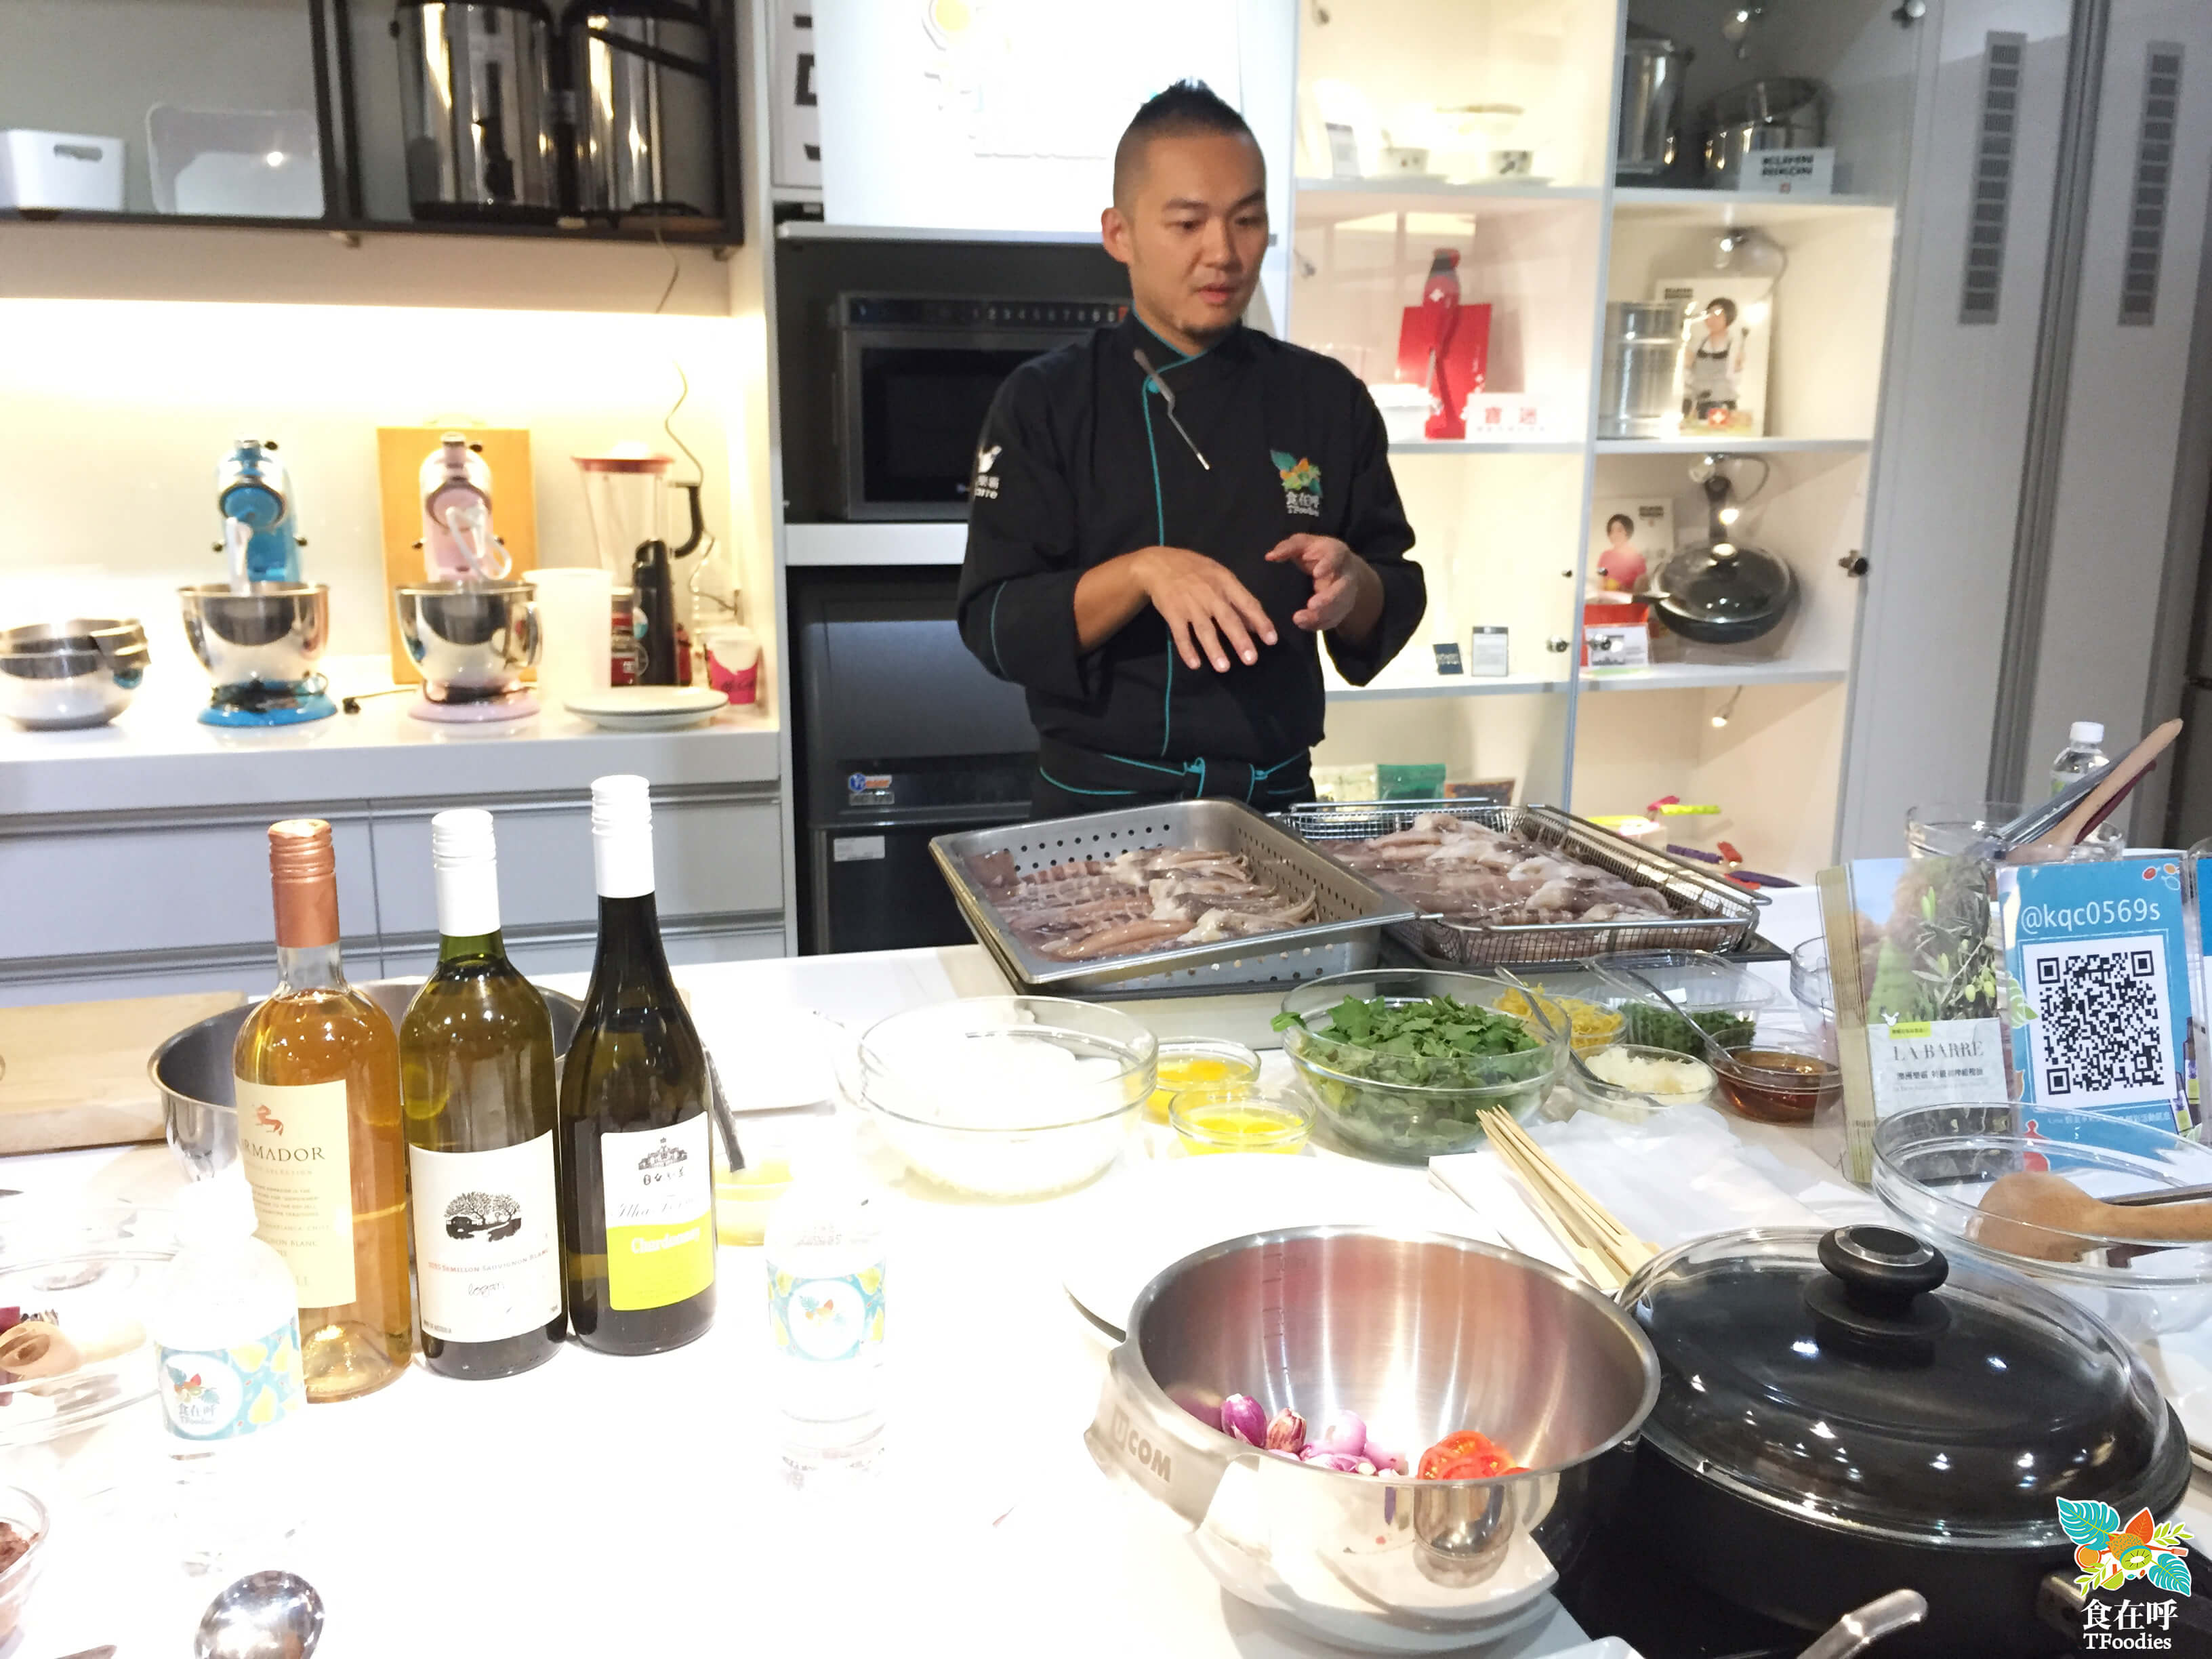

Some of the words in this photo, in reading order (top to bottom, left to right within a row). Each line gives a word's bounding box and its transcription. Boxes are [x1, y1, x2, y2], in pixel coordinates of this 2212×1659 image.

[2022, 898, 2160, 935] @kqc0569s
[1893, 1045, 1919, 1061] LA
[1923, 1040, 1984, 1059] BARRE
